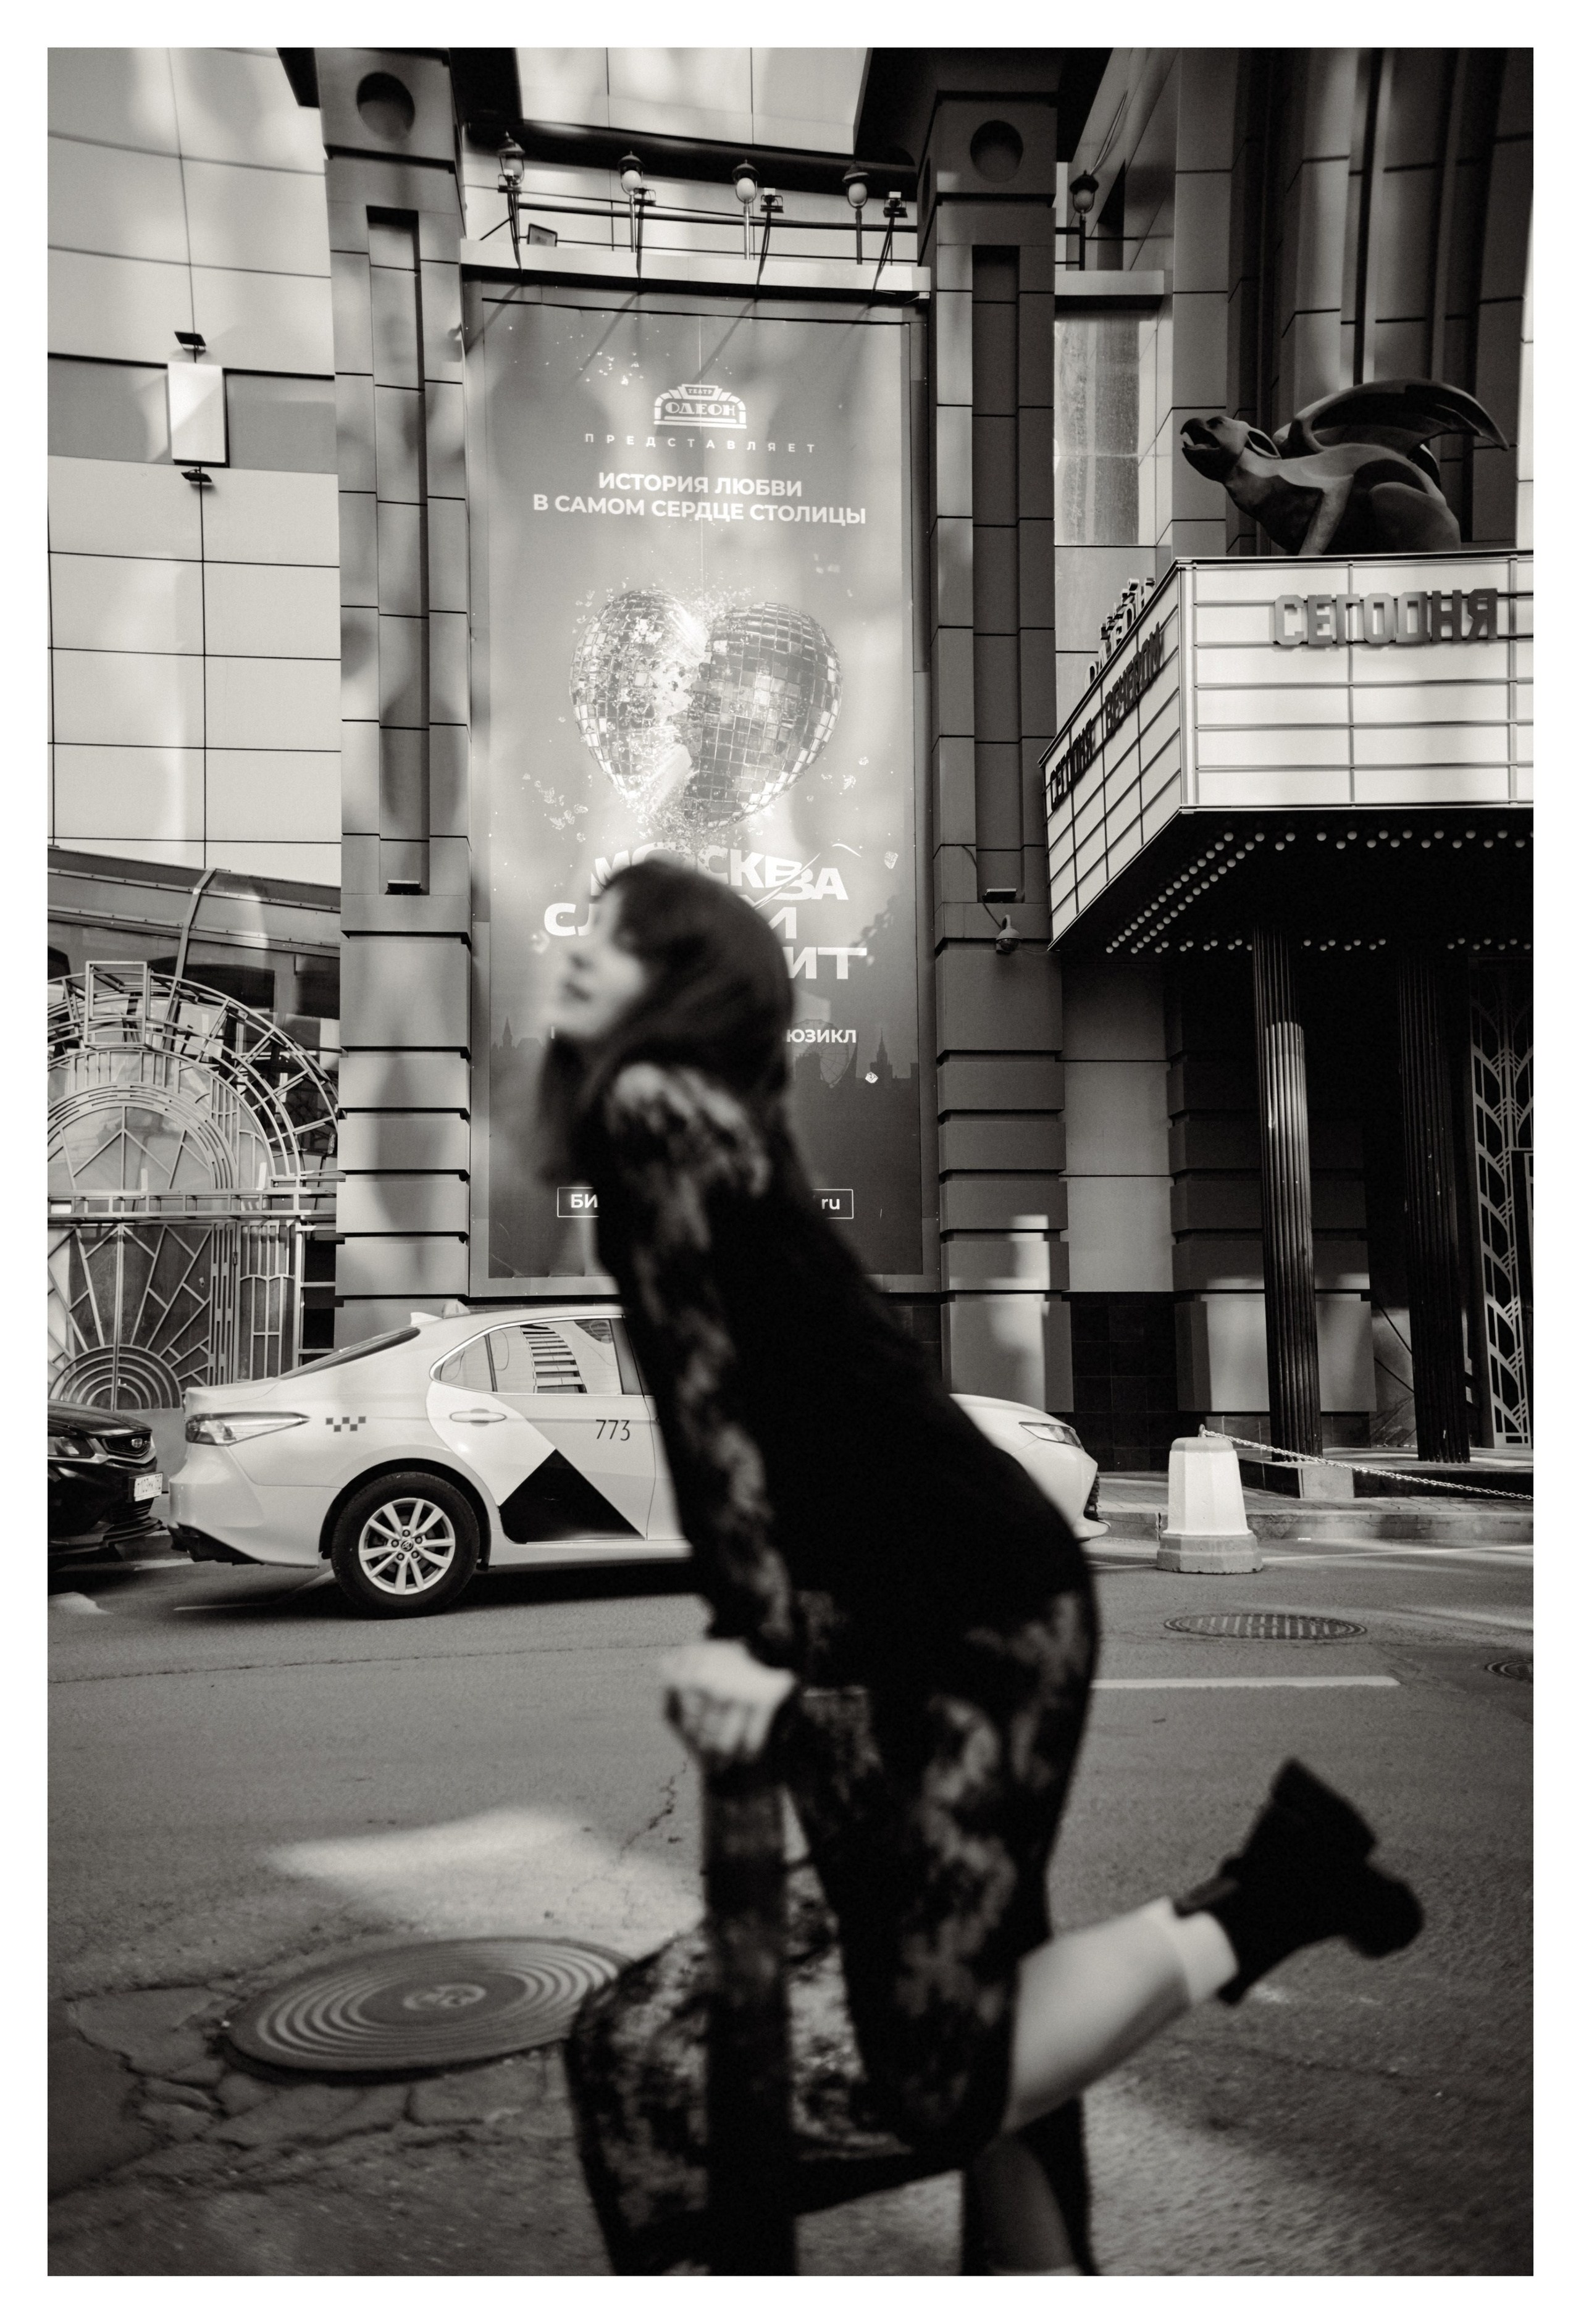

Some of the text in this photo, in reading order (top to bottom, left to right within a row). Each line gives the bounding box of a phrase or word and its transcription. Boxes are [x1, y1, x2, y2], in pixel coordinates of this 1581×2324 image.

[665, 402, 736, 416] ОДЕОН
[585, 433, 815, 453] ПРЕДСТАВЛЯЕТ
[598, 472, 802, 497] ИСТОРИЯ ЛЮБВИ
[533, 494, 866, 525] В САМОМ СЕРДЦЕ СТОЛИЦЫ
[1273, 588, 1498, 646] СЕГОДНЯ
[1051, 717, 1092, 811] СЕГОДНЯ
[1104, 621, 1160, 738] ВЕЧЕРОМ
[786, 1029, 857, 1043] ЮЗИКЛ
[595, 1419, 631, 1441] 773
